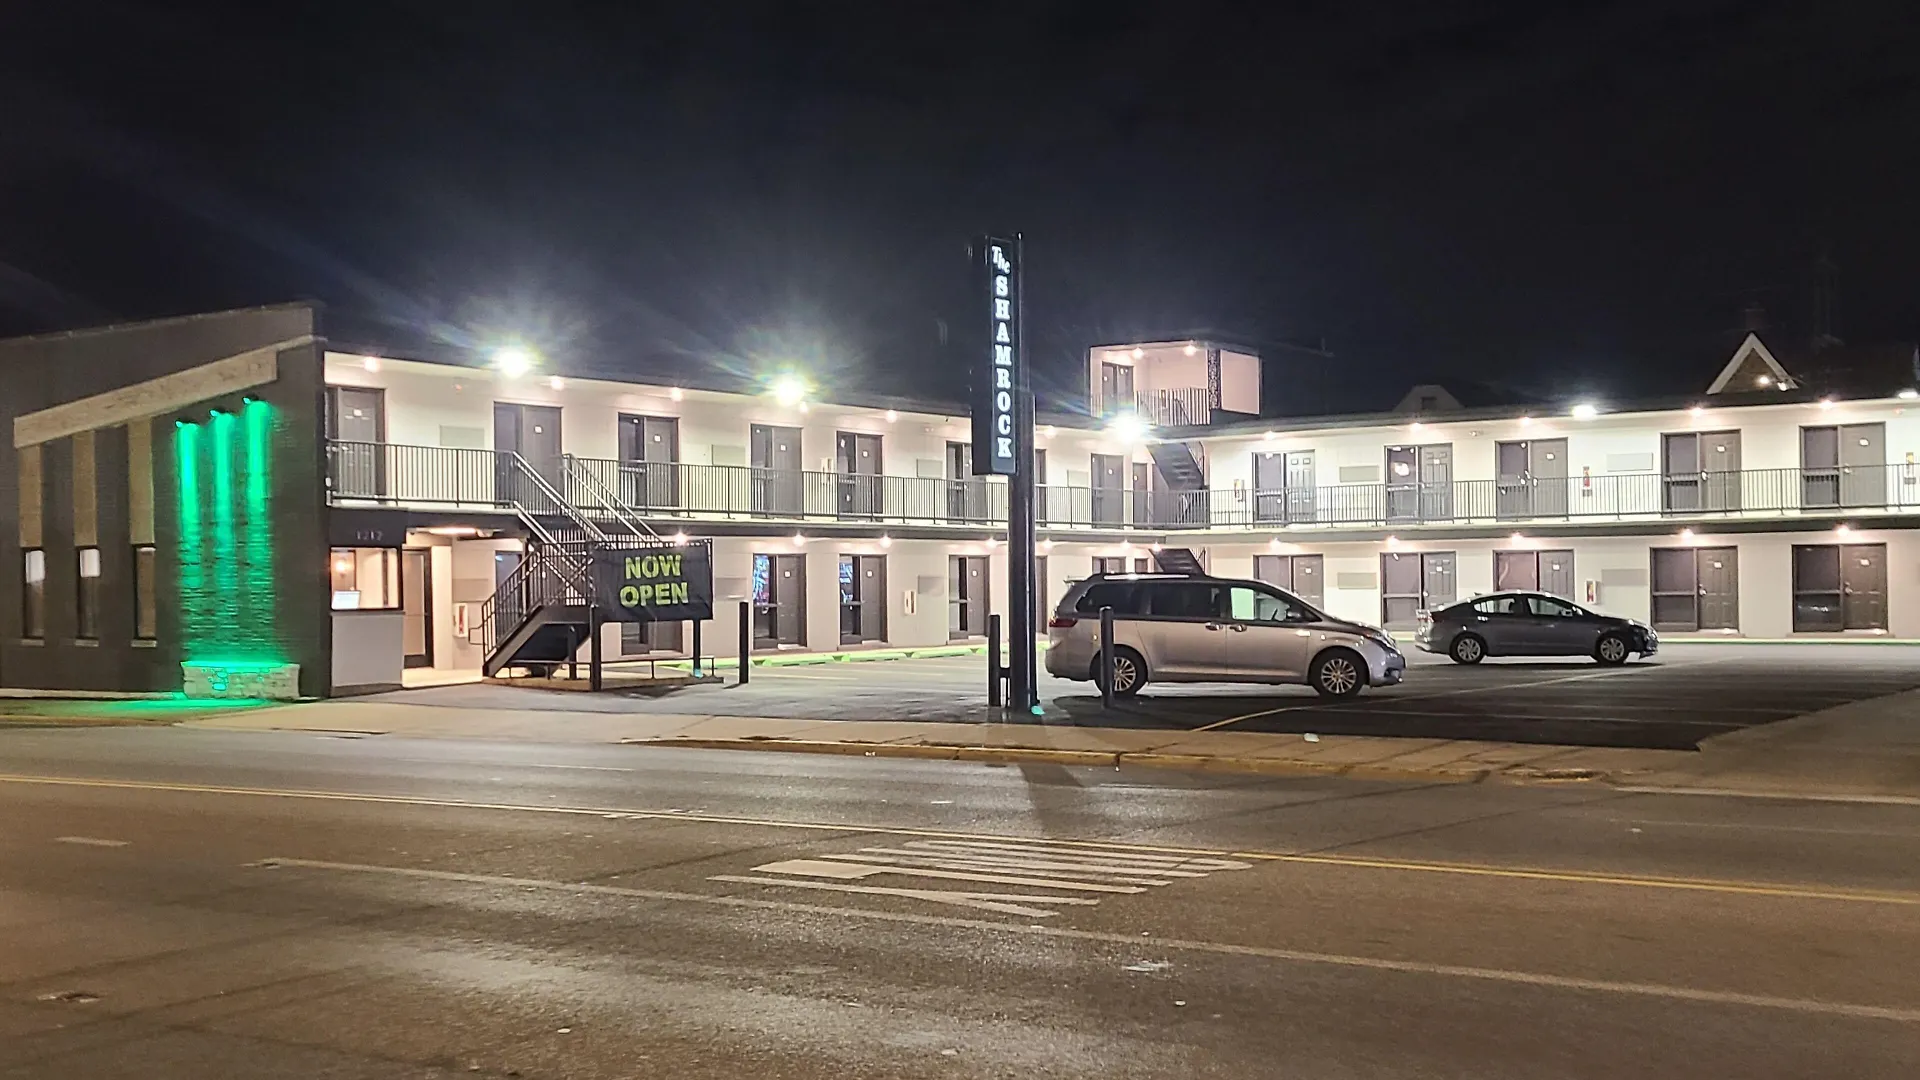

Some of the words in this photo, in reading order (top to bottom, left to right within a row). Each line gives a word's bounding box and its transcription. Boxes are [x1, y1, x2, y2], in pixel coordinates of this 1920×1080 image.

[991, 245, 1011, 274] The
[994, 275, 1013, 458] SHAMROCK
[625, 555, 682, 579] NOW
[620, 582, 689, 608] OPEN
